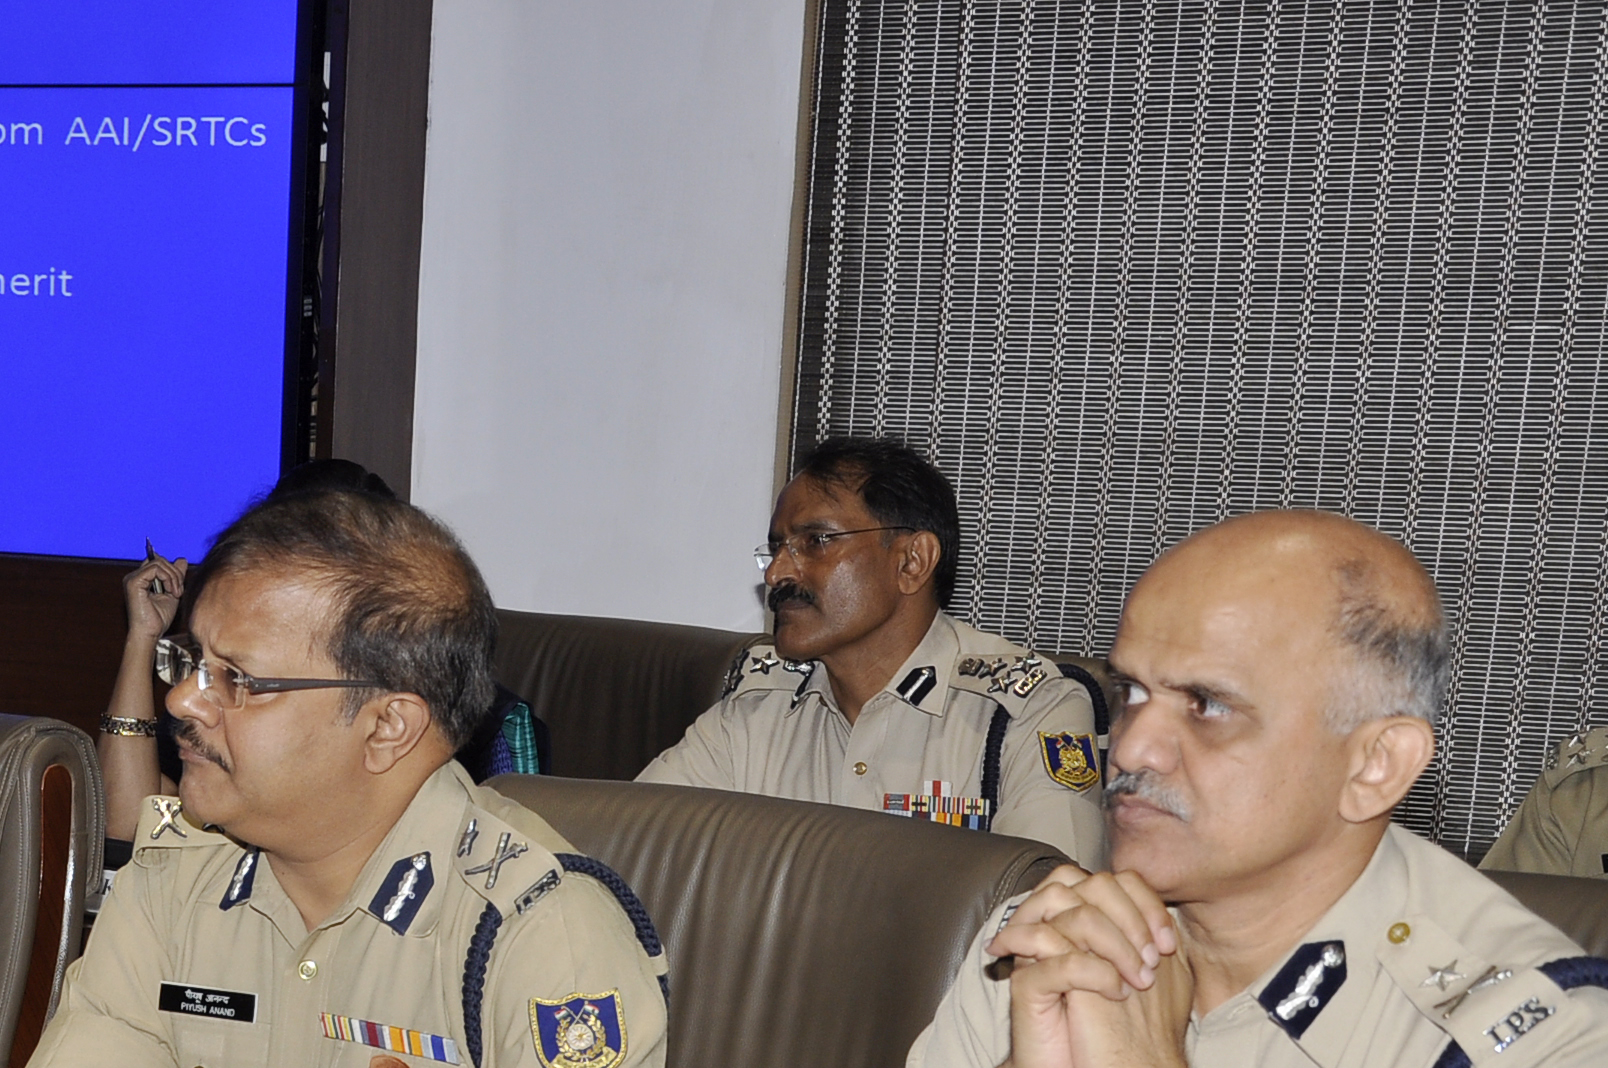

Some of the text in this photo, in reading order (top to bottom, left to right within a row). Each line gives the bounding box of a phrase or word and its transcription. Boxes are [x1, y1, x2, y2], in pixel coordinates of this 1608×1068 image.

[64, 113, 267, 153] AAI/SRTCs
[180, 1002, 235, 1017] PIYUSH ANAND
